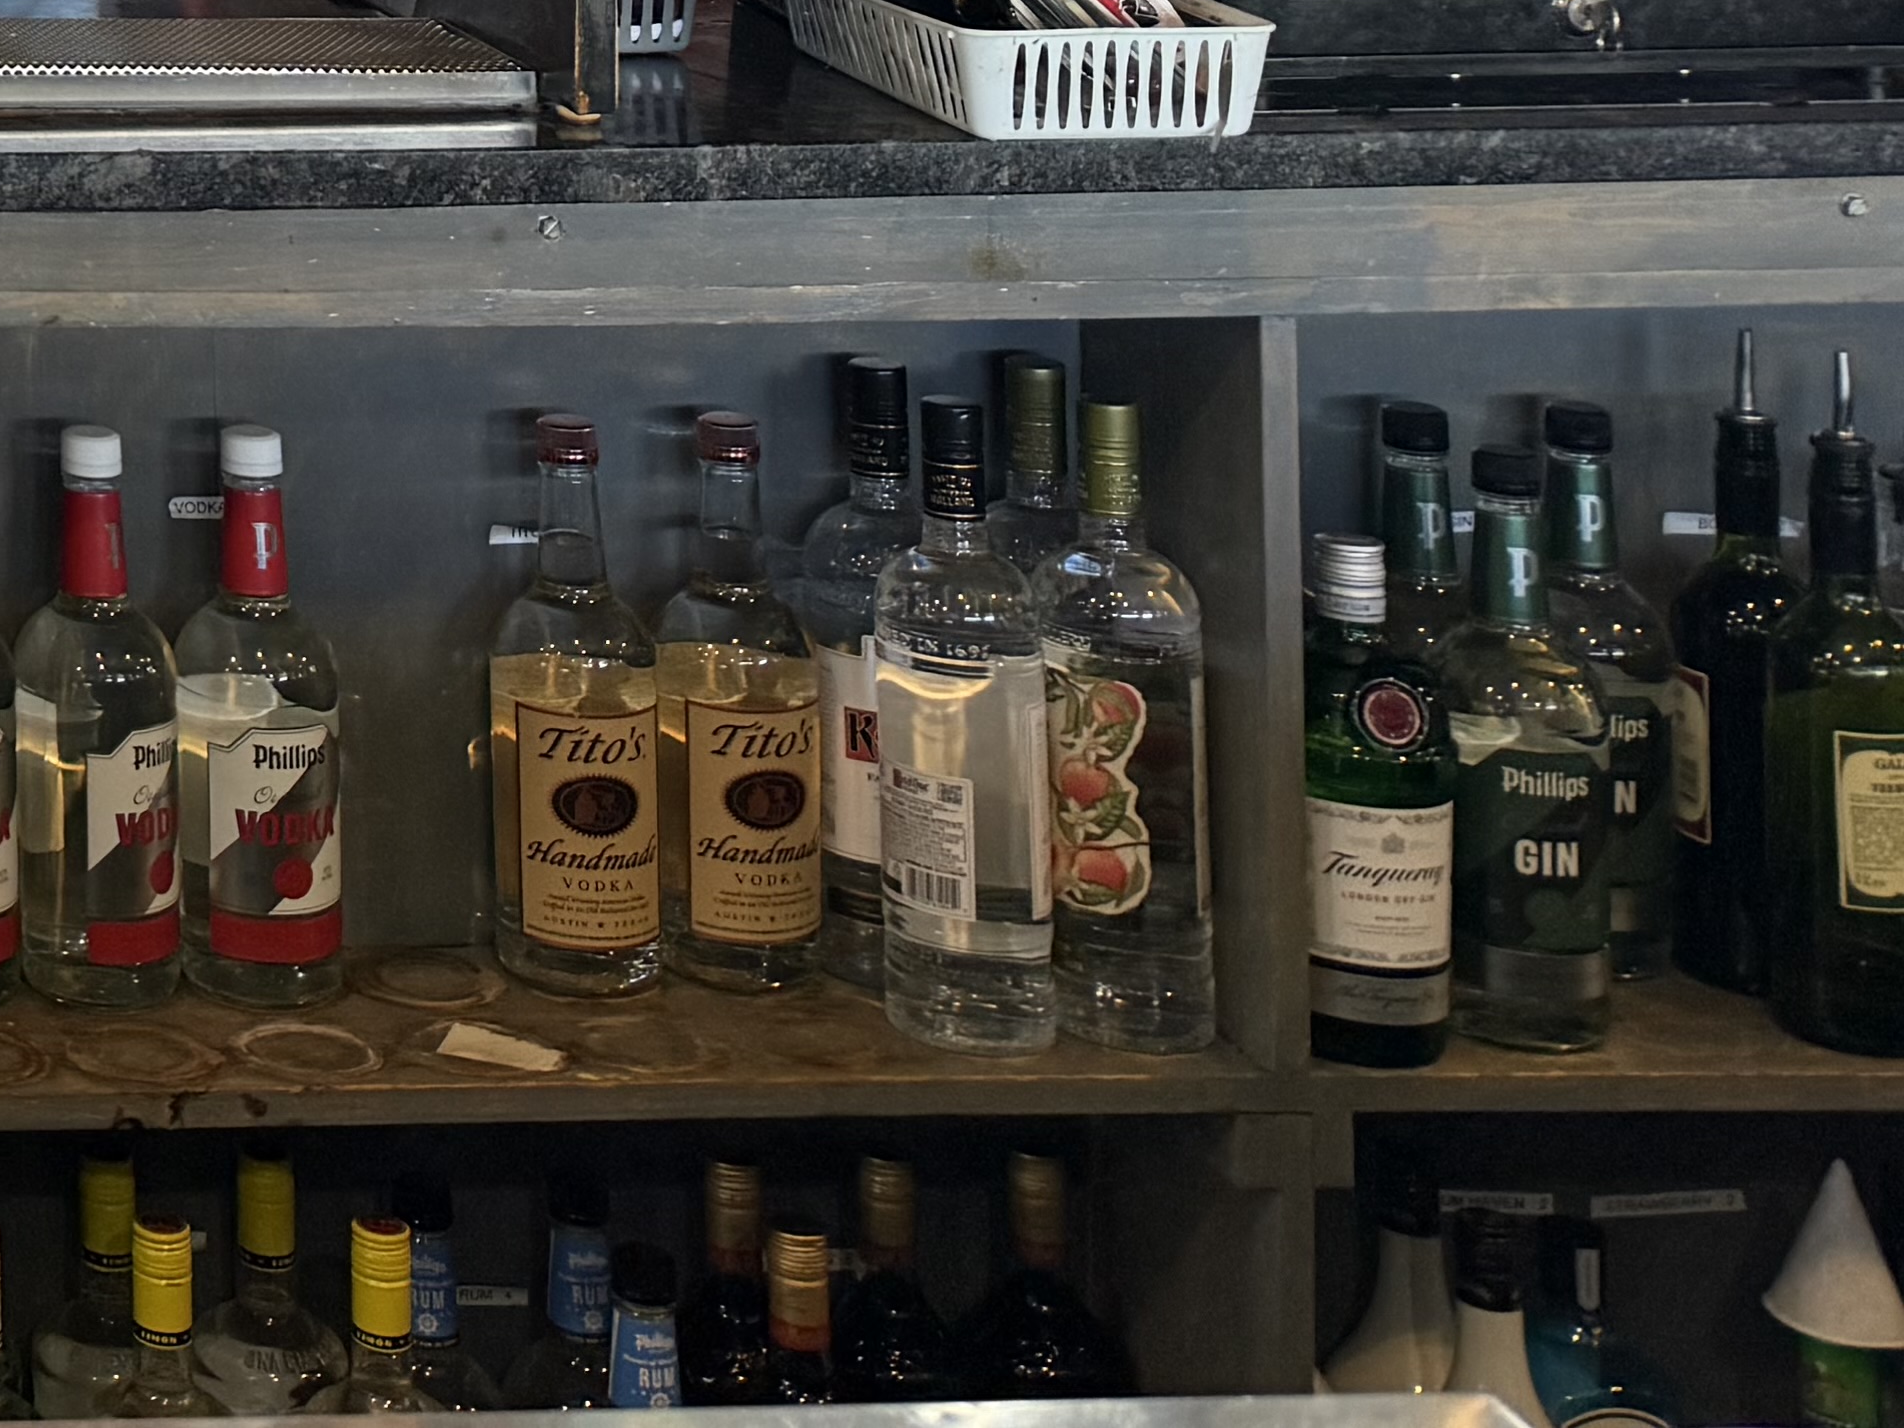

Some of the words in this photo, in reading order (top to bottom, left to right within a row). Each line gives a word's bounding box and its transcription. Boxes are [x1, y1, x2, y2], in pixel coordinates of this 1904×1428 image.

[253, 743, 325, 769] Phillips
[539, 726, 646, 764] Tito's
[1503, 767, 1589, 800] Phillips
[237, 809, 334, 848] VODKA
[526, 837, 657, 872] Handmade
[1323, 852, 1444, 886] Tanqueray
[1515, 840, 1579, 877] GIN
[562, 877, 634, 892] VODKA
[639, 1368, 674, 1388] RUM
